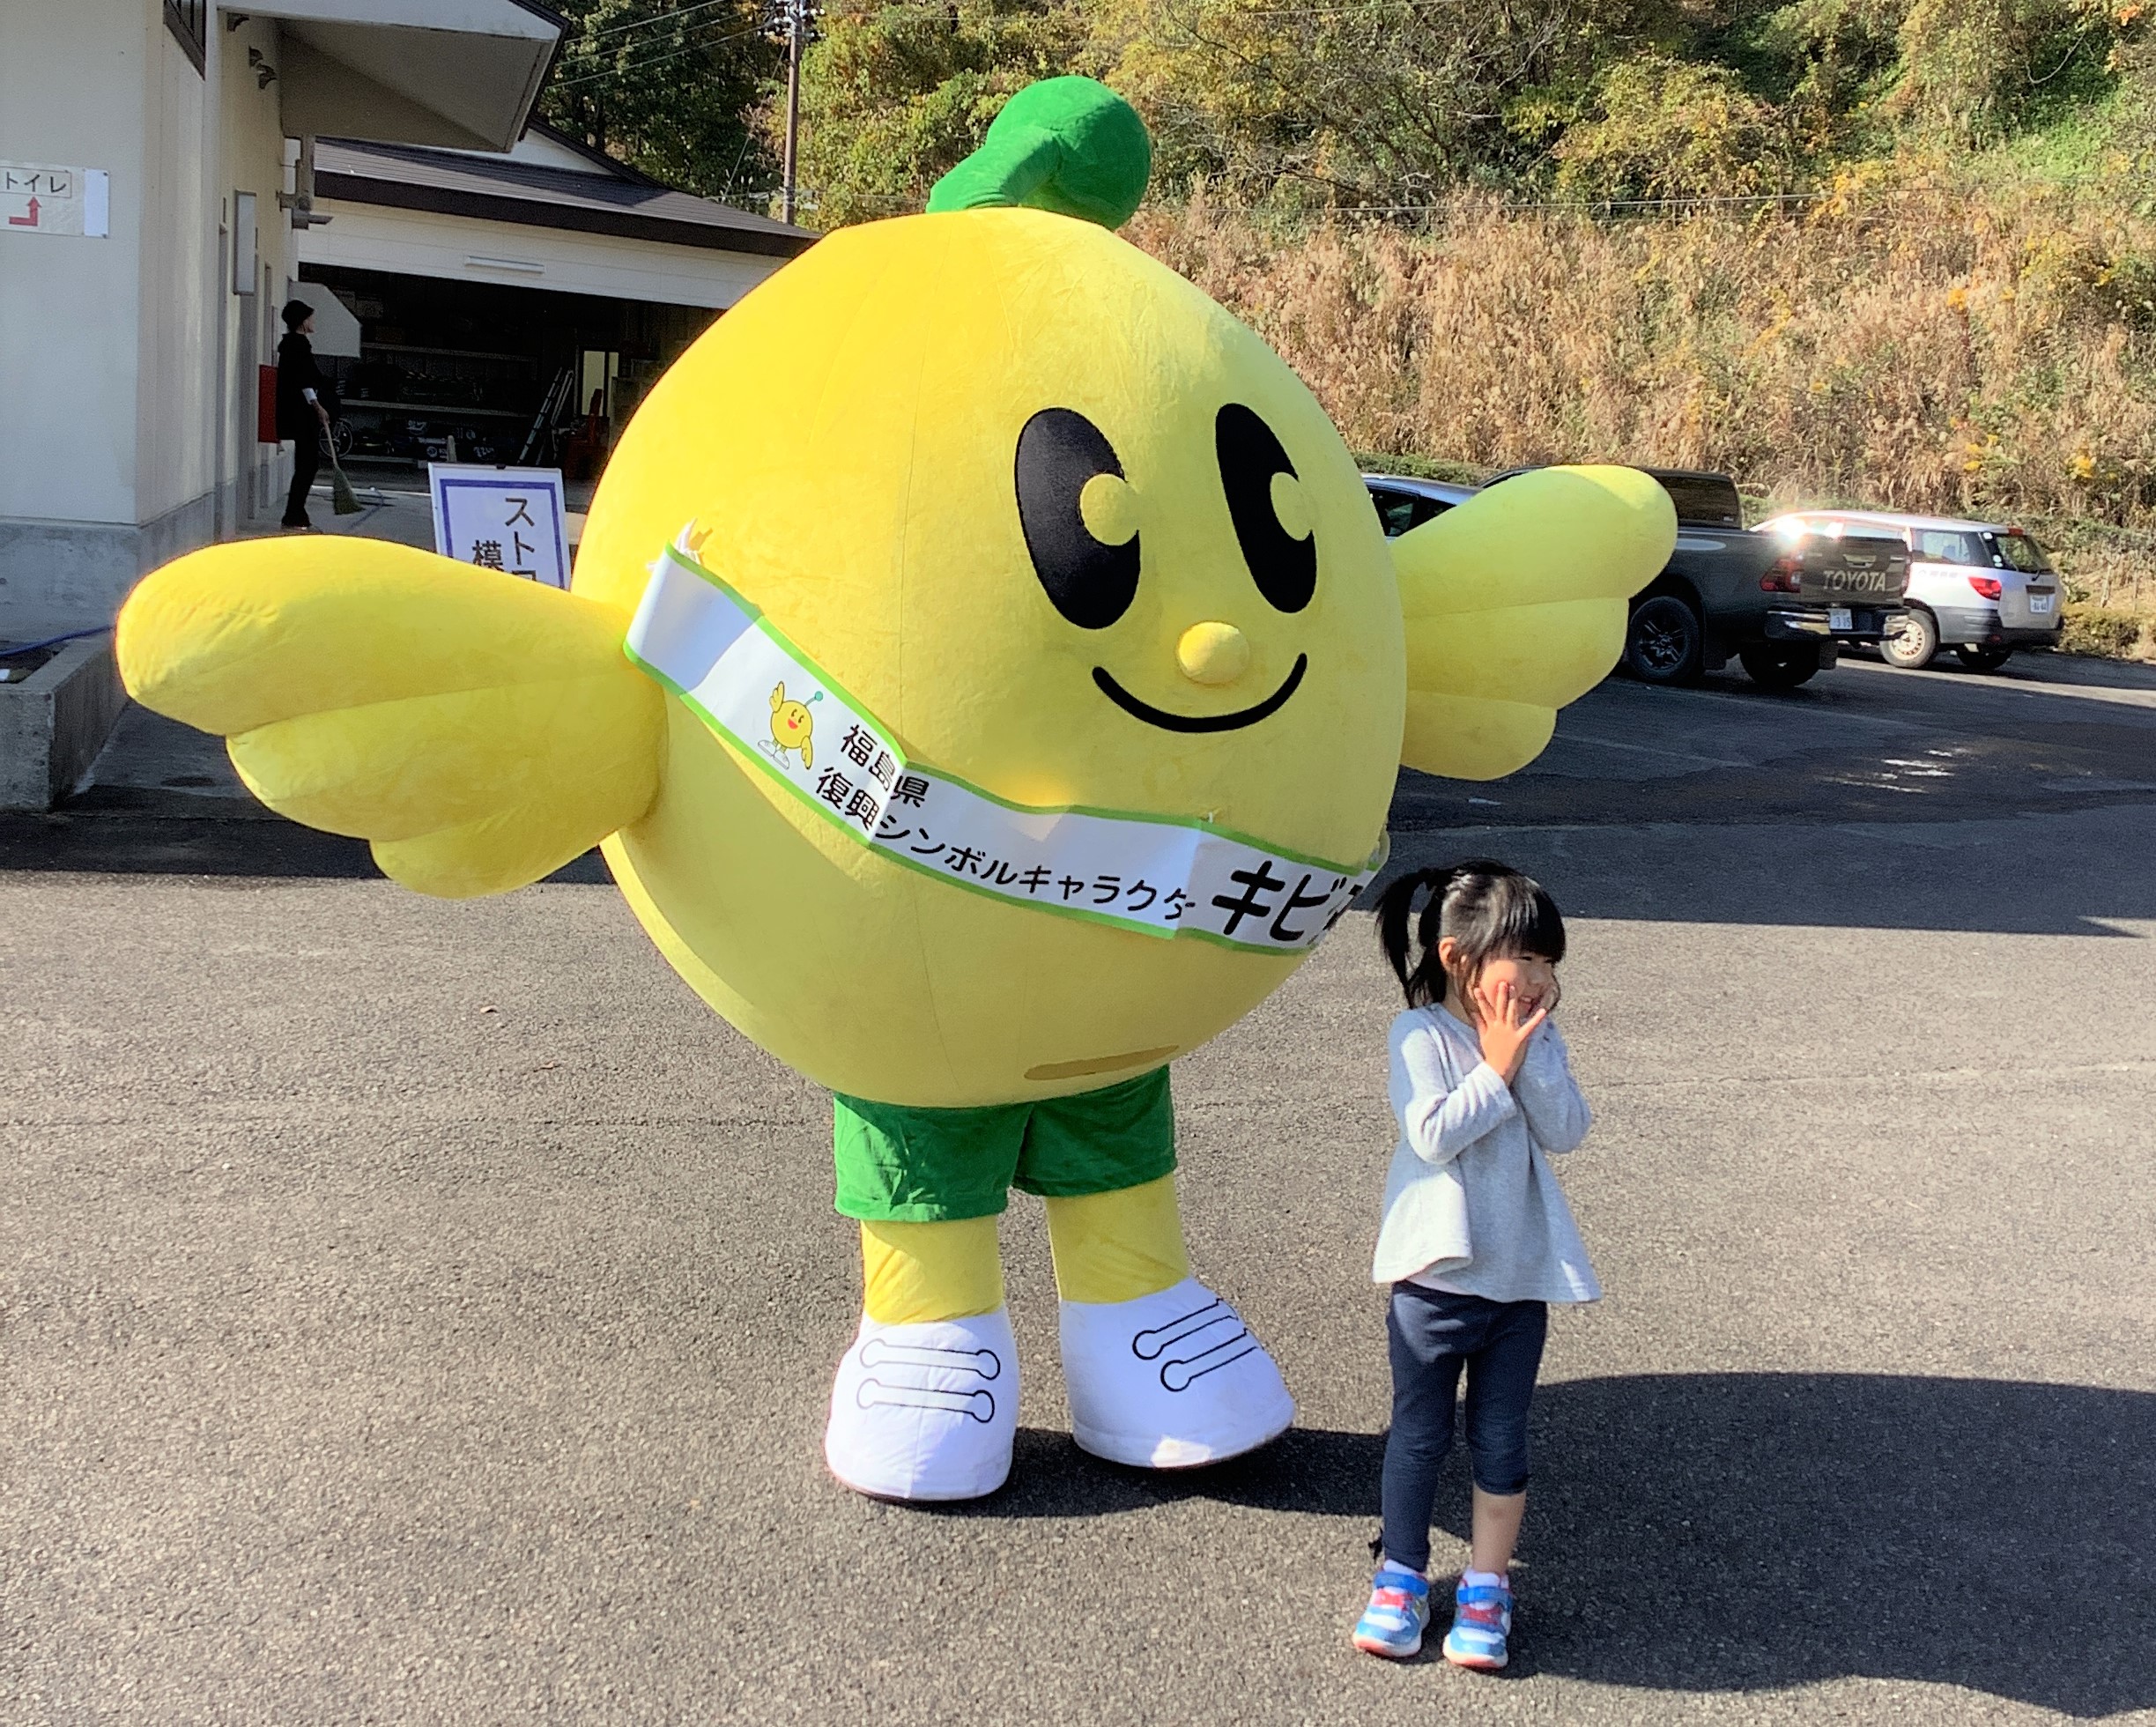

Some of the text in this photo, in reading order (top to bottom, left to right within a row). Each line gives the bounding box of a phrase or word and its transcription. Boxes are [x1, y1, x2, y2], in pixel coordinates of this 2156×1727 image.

[6, 172, 67, 193] トイレ
[1823, 570, 1887, 592] TOYOTA
[840, 723, 930, 808] 福島県
